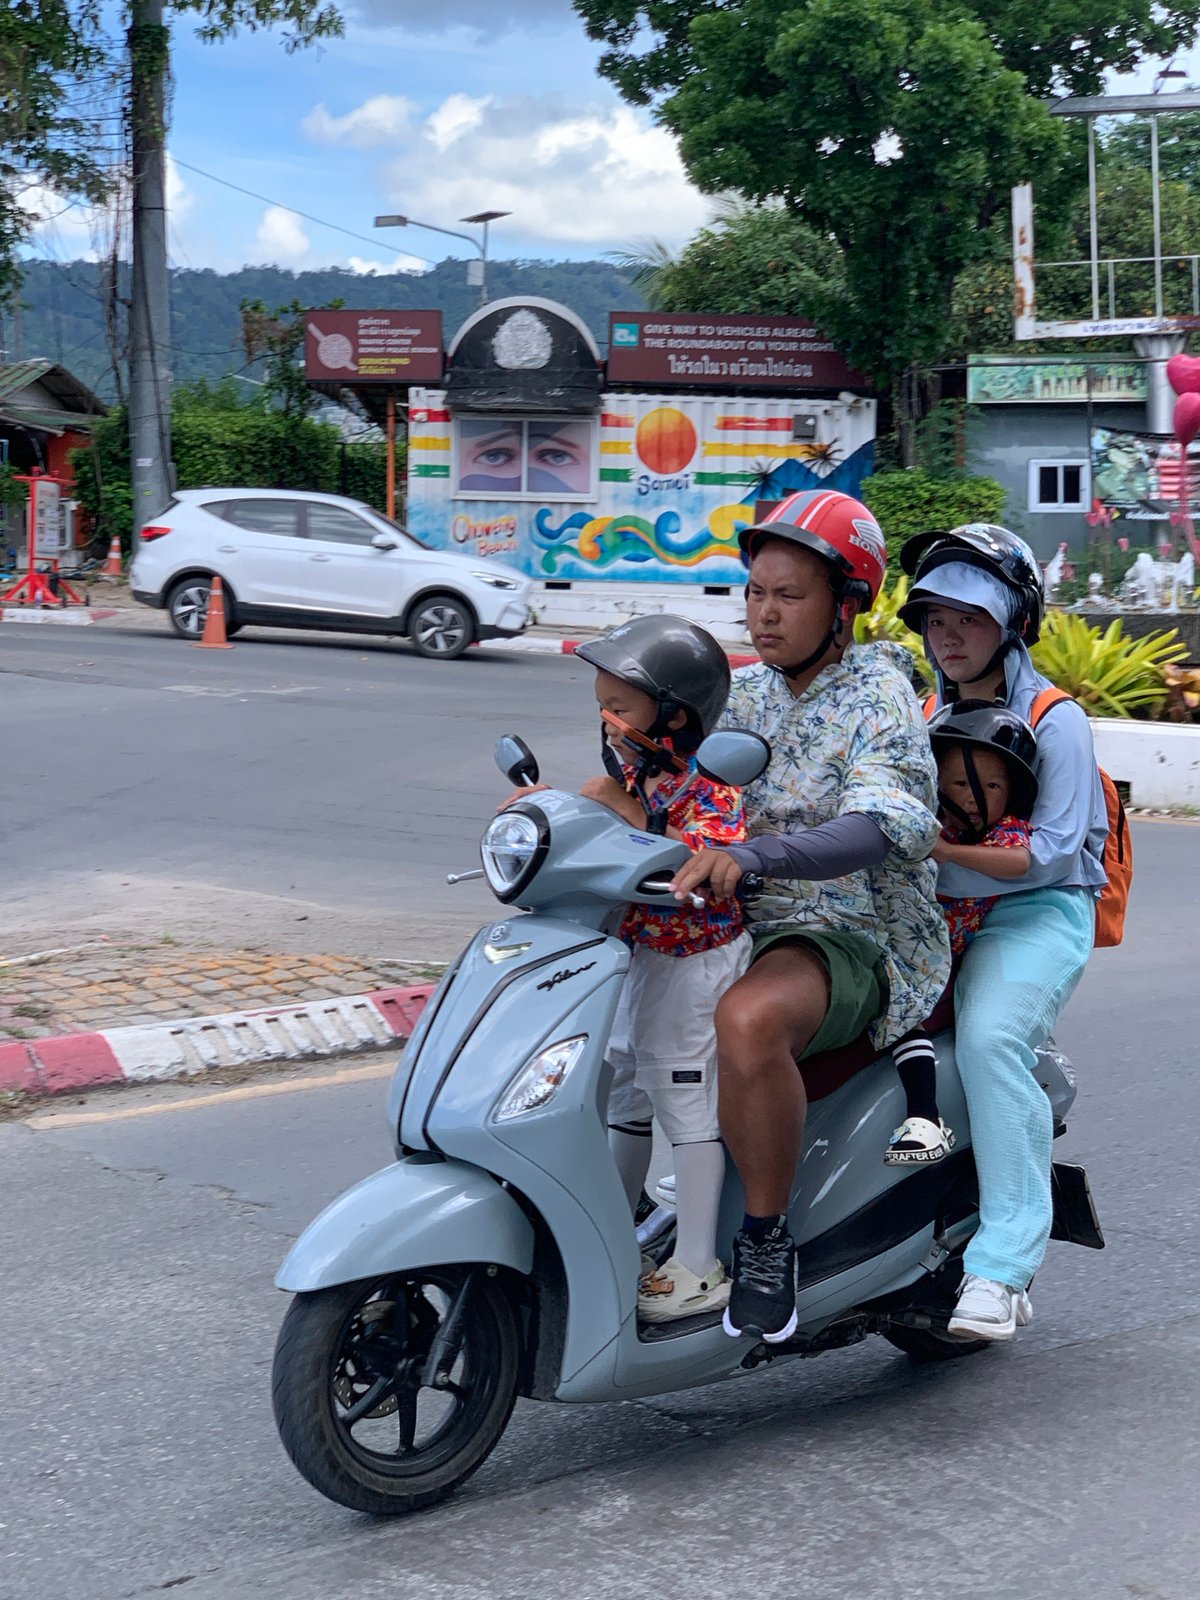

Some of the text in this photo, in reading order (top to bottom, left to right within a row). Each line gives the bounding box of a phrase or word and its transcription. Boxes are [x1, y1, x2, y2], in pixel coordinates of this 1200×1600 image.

[643, 324, 818, 338] GIVE WAY TO VEHICLES ALREAD
[642, 338, 667, 349] THE
[666, 338, 746, 350] ROUNDABOUT
[746, 340, 766, 351] ON
[767, 341, 800, 352] YOUR
